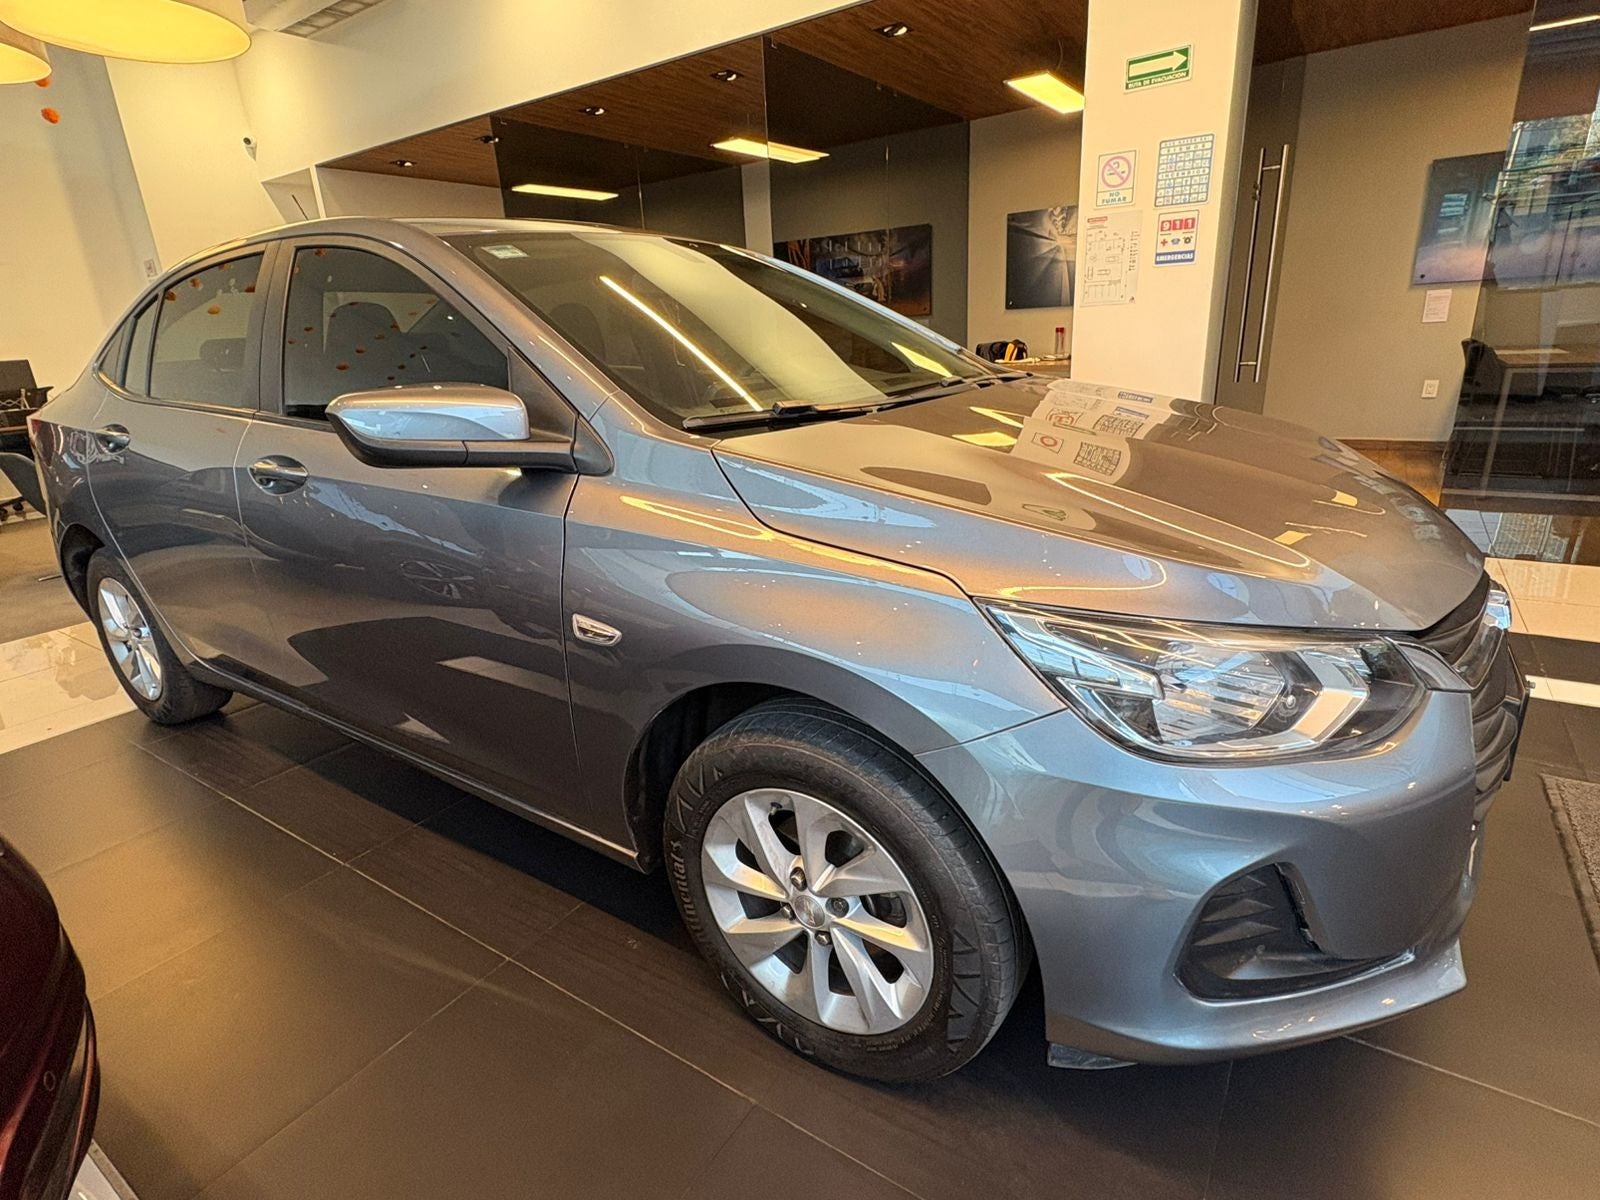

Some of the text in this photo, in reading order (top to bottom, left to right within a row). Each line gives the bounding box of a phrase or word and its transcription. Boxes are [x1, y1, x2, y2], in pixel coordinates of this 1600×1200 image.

[1128, 81, 1142, 89] RUTA
[1101, 196, 1127, 204] FUMAR
[1162, 218, 1194, 231] 911
[1156, 252, 1194, 262] EMERGENCIAS
